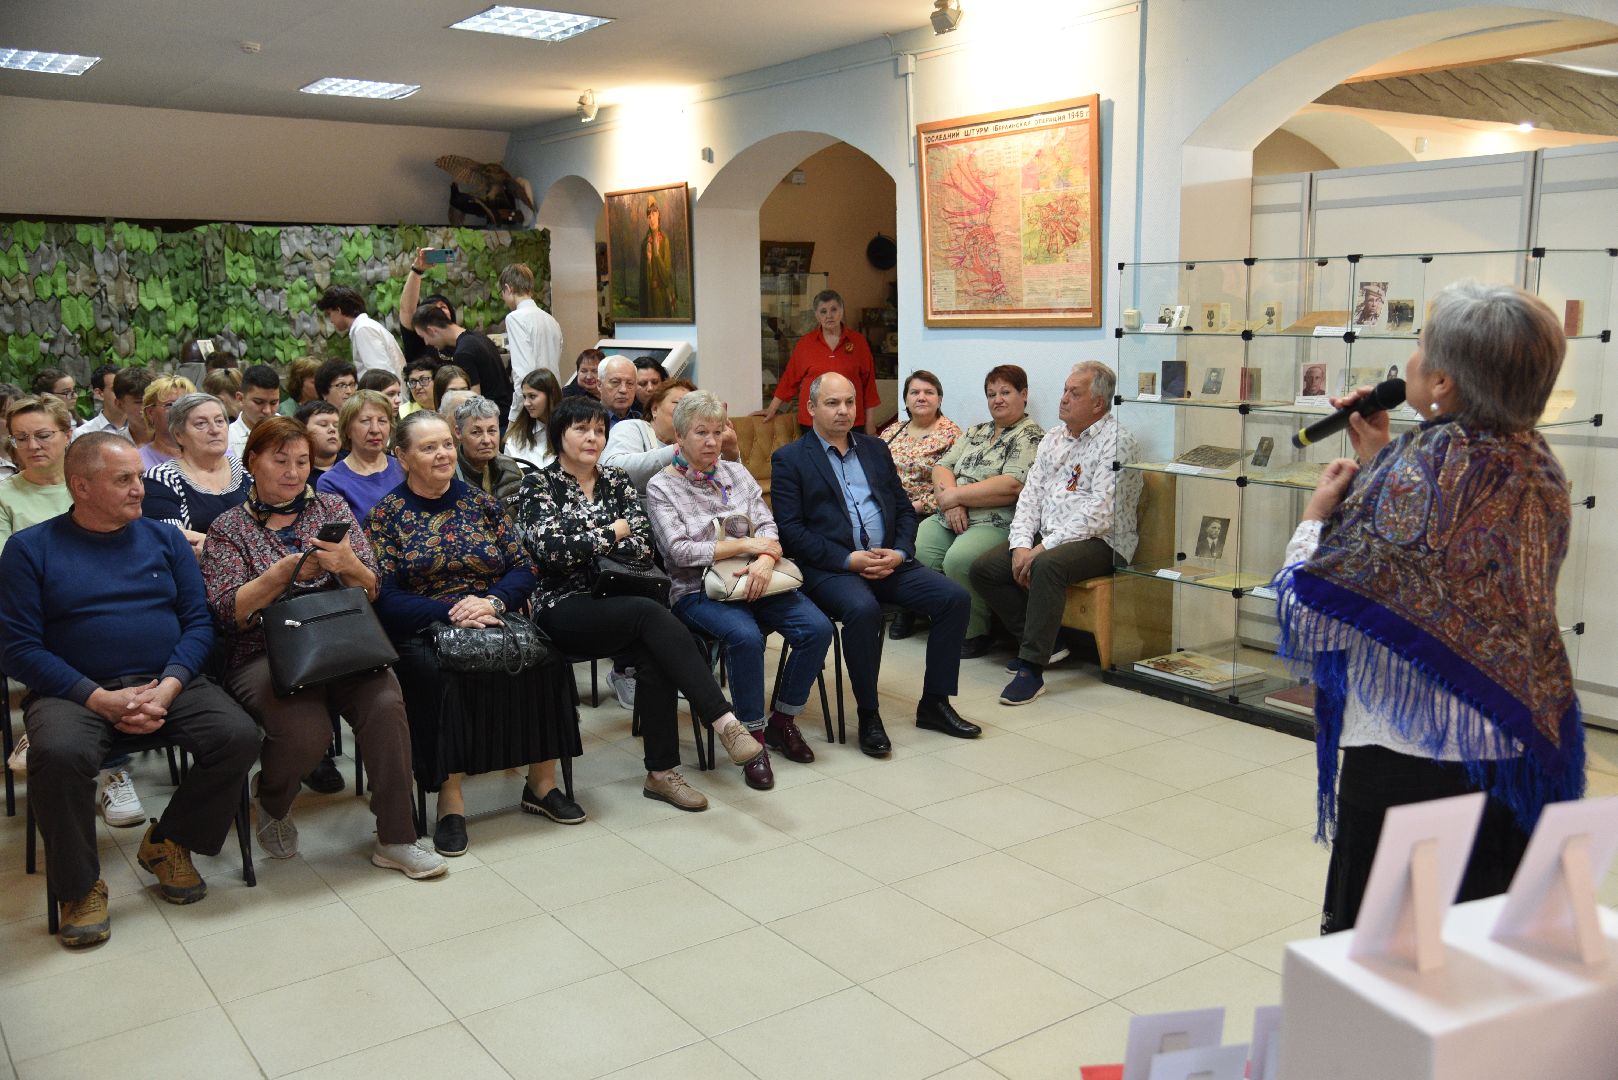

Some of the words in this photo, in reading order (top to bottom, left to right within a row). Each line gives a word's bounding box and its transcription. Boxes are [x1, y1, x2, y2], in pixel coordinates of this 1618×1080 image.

[924, 129, 960, 144] ПОСЛЕДНИЙ
[964, 126, 989, 137] ШТУРМ
[1068, 110, 1084, 119] 1945
